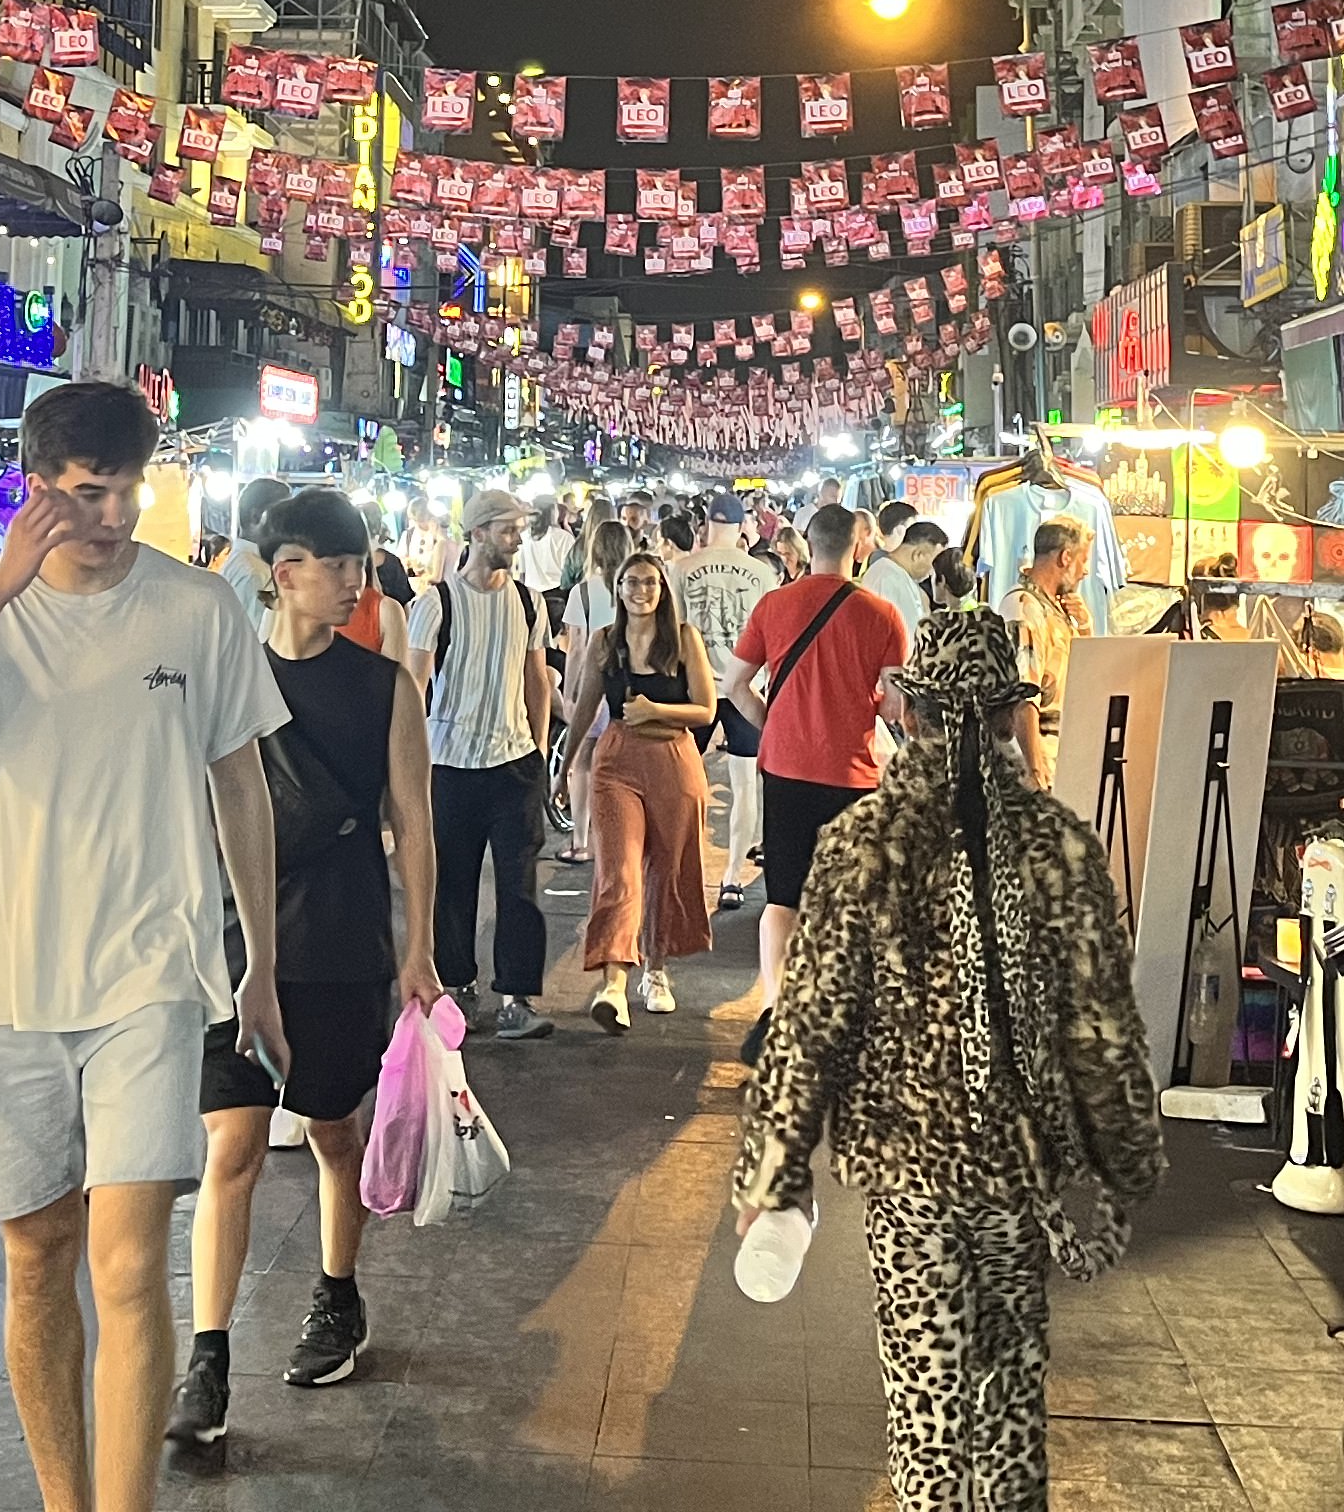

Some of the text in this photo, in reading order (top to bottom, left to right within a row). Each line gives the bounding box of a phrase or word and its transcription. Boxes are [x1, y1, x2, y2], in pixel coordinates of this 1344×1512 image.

[58, 34, 89, 48] LEO
[1195, 50, 1227, 68] LEO
[280, 83, 314, 99] LEO
[1007, 84, 1040, 99] LEO
[1277, 89, 1306, 104] LEO
[431, 99, 464, 114] LEO
[809, 104, 843, 119] LEO
[626, 108, 659, 122] LEO
[185, 131, 214, 147] LEO
[1130, 130, 1159, 146] LEO
[967, 165, 994, 178] LEO
[1085, 161, 1110, 174] LEO
[288, 177, 314, 189] LEO
[441, 183, 468, 196] LEO
[526, 193, 553, 204] LEO
[812, 185, 840, 198] LEO
[643, 193, 672, 206] LEO
[435, 230, 455, 241] LEO
[906, 476, 959, 497] BEST
[687, 564, 760, 588] AUTHENTIC
